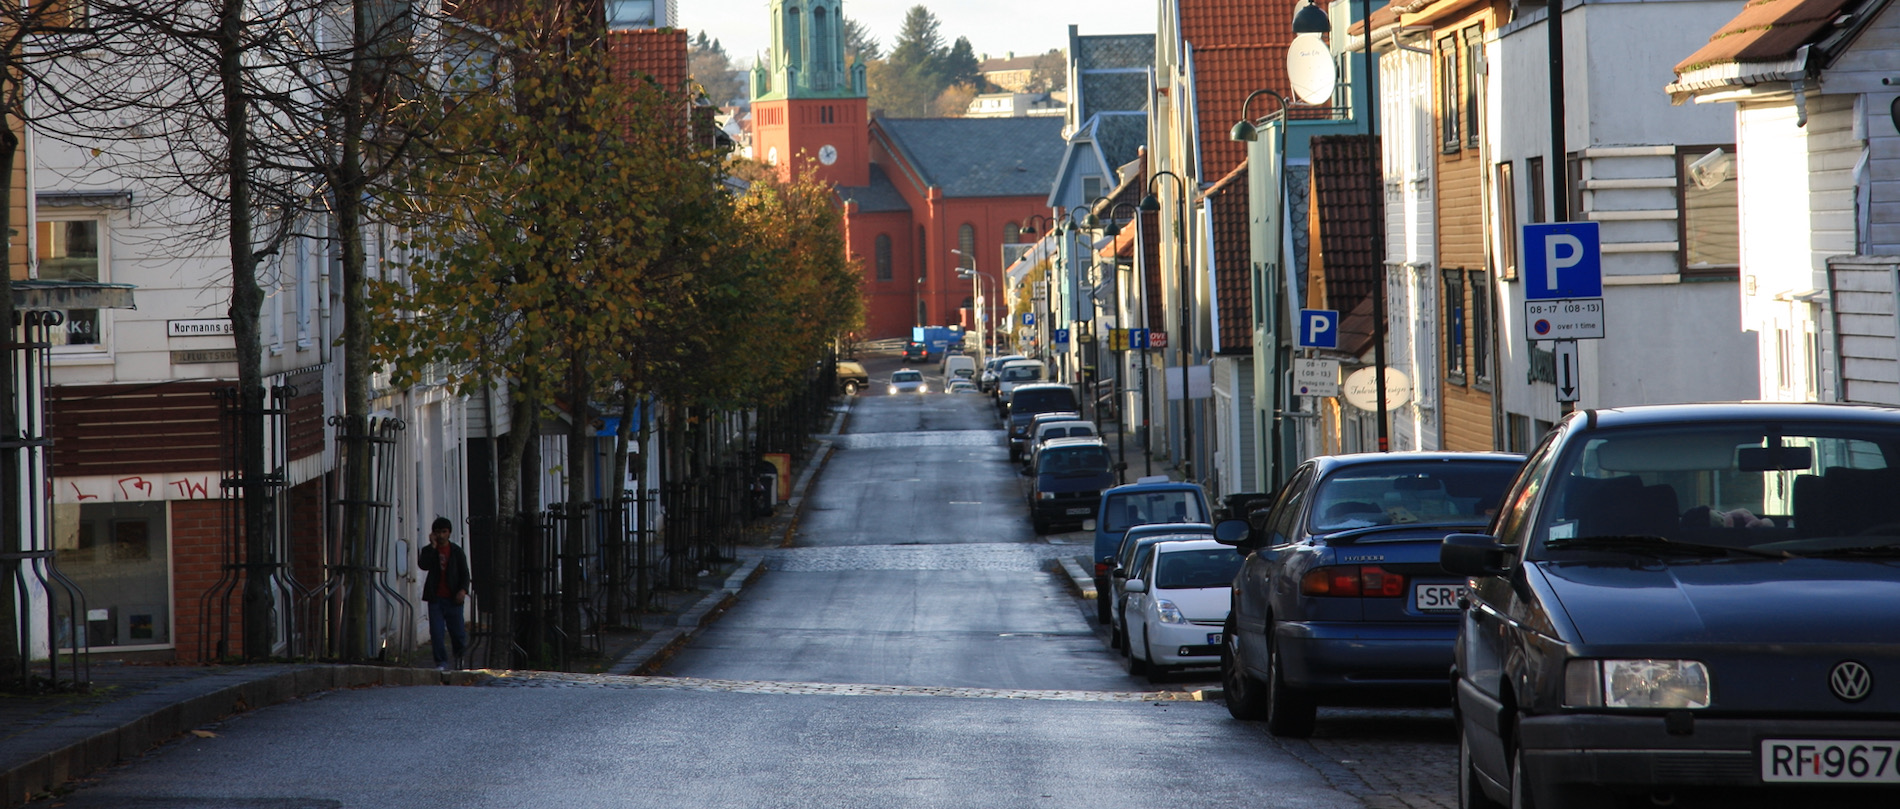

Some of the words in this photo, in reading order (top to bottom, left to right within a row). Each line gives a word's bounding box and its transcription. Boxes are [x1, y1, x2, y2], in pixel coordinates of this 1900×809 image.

[1544, 234, 1584, 290] P
[1025, 314, 1033, 324] P
[1580, 321, 1596, 329] time
[174, 322, 220, 333] Normanns
[223, 323, 234, 334] ga
[1309, 315, 1330, 343] P
[1059, 330, 1067, 342] P
[1823, 744, 1900, 778] 967
